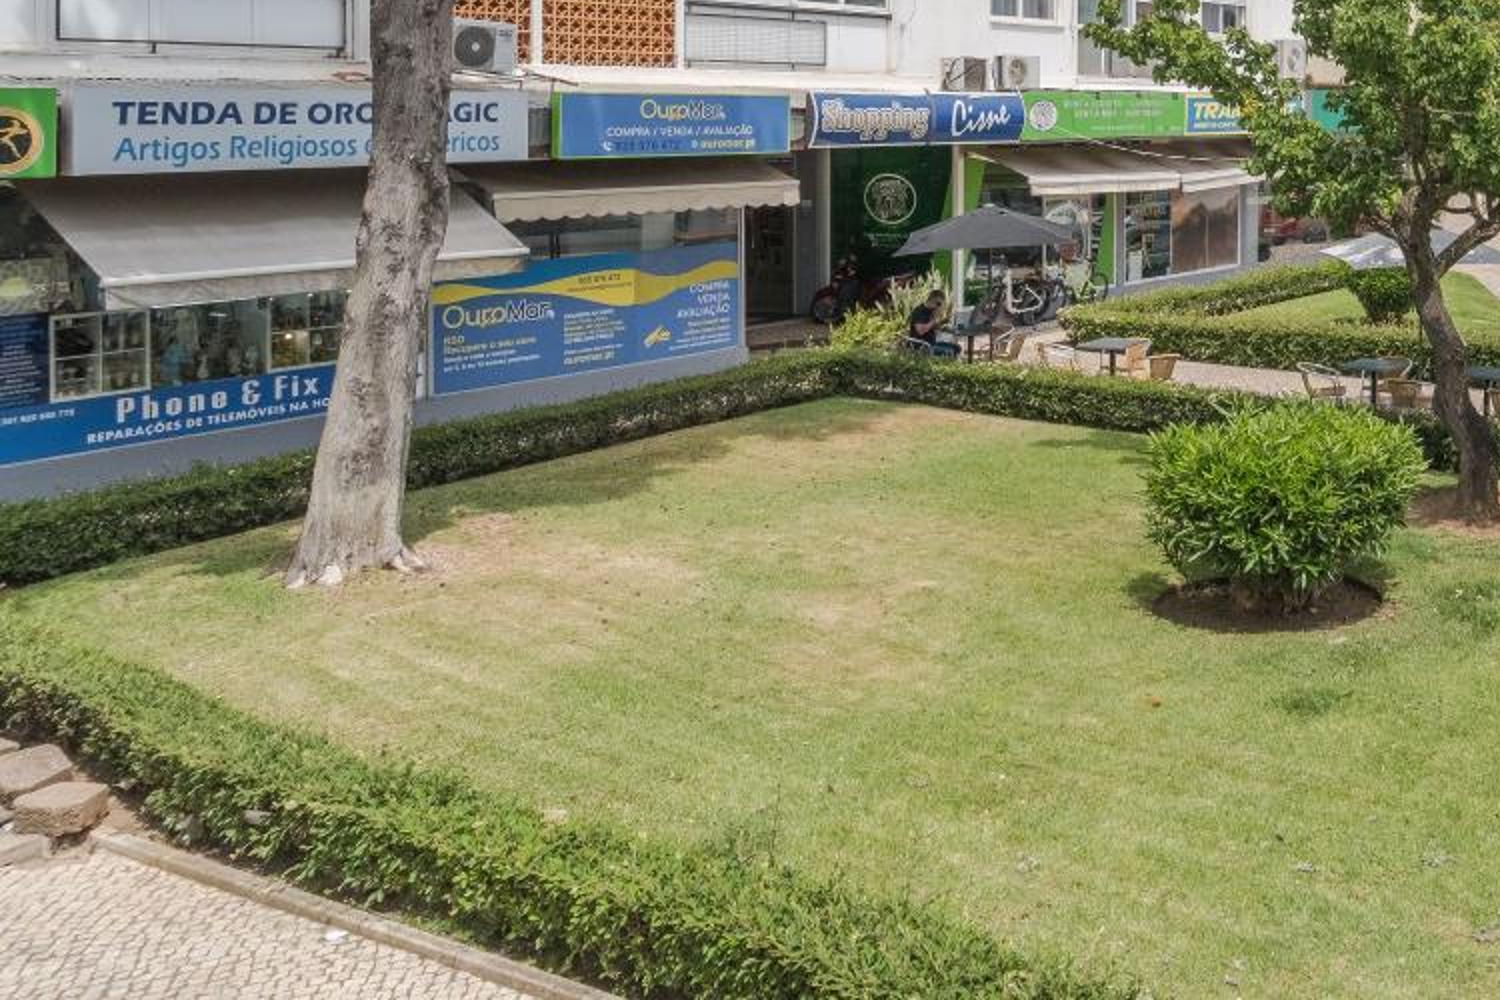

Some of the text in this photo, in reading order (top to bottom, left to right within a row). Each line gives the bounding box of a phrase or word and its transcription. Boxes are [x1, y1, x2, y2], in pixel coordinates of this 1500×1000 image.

[113, 101, 243, 125] TENDA
[254, 102, 298, 125] DE
[607, 126, 650, 137] COMPRA
[661, 126, 692, 136] VENDA
[703, 123, 753, 137] AVALIAÇÃO
[821, 98, 930, 140] Shopping
[113, 135, 221, 167] Artigos
[230, 134, 358, 165] Religiosos
[116, 376, 318, 423] Phone & Fix
[87, 418, 182, 443] REPARAÇÕES
[186, 416, 203, 428] DE
[207, 402, 286, 426] TELEMÓVEIS
[290, 401, 309, 412] NA
